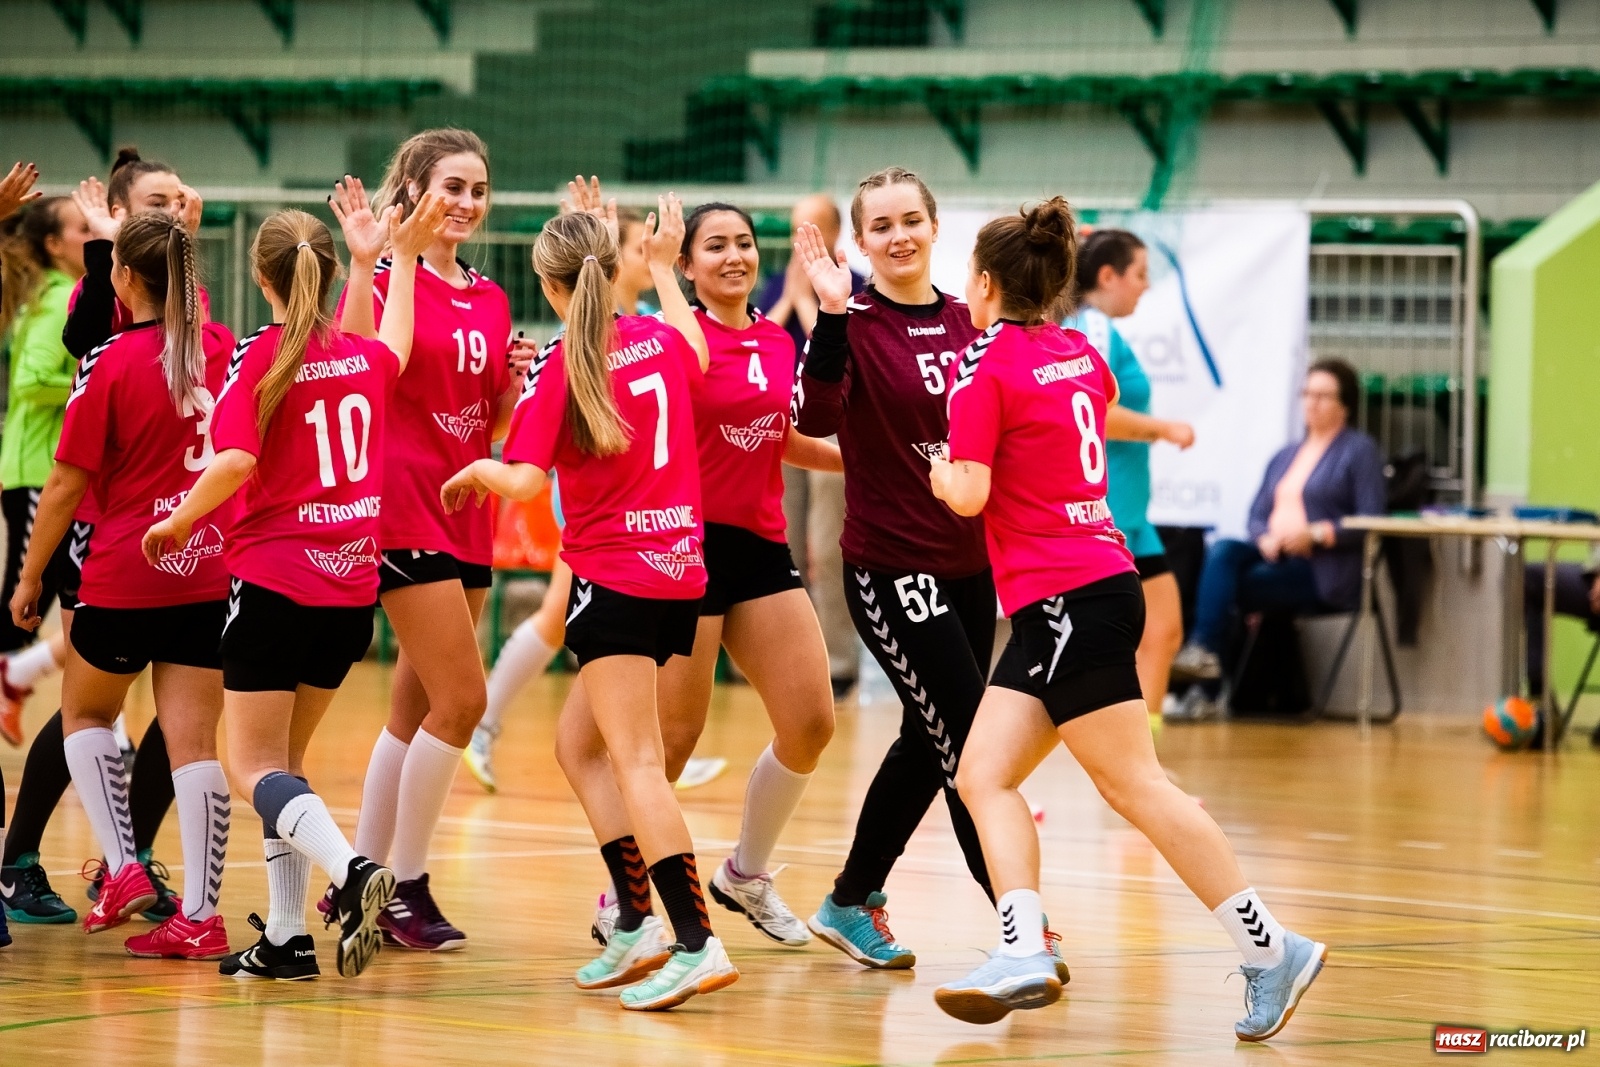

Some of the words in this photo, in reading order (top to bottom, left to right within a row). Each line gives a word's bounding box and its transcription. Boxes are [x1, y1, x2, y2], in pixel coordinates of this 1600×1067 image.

[452, 328, 487, 375] 19
[605, 337, 664, 371] OZNAŃSKA
[907, 324, 946, 337] hummel
[747, 353, 768, 391] 4
[183, 386, 216, 472] 3
[305, 393, 371, 487] 10
[628, 372, 668, 470] 7
[1072, 391, 1105, 484] 8
[160, 541, 223, 561] echControl
[894, 573, 949, 622] 52
